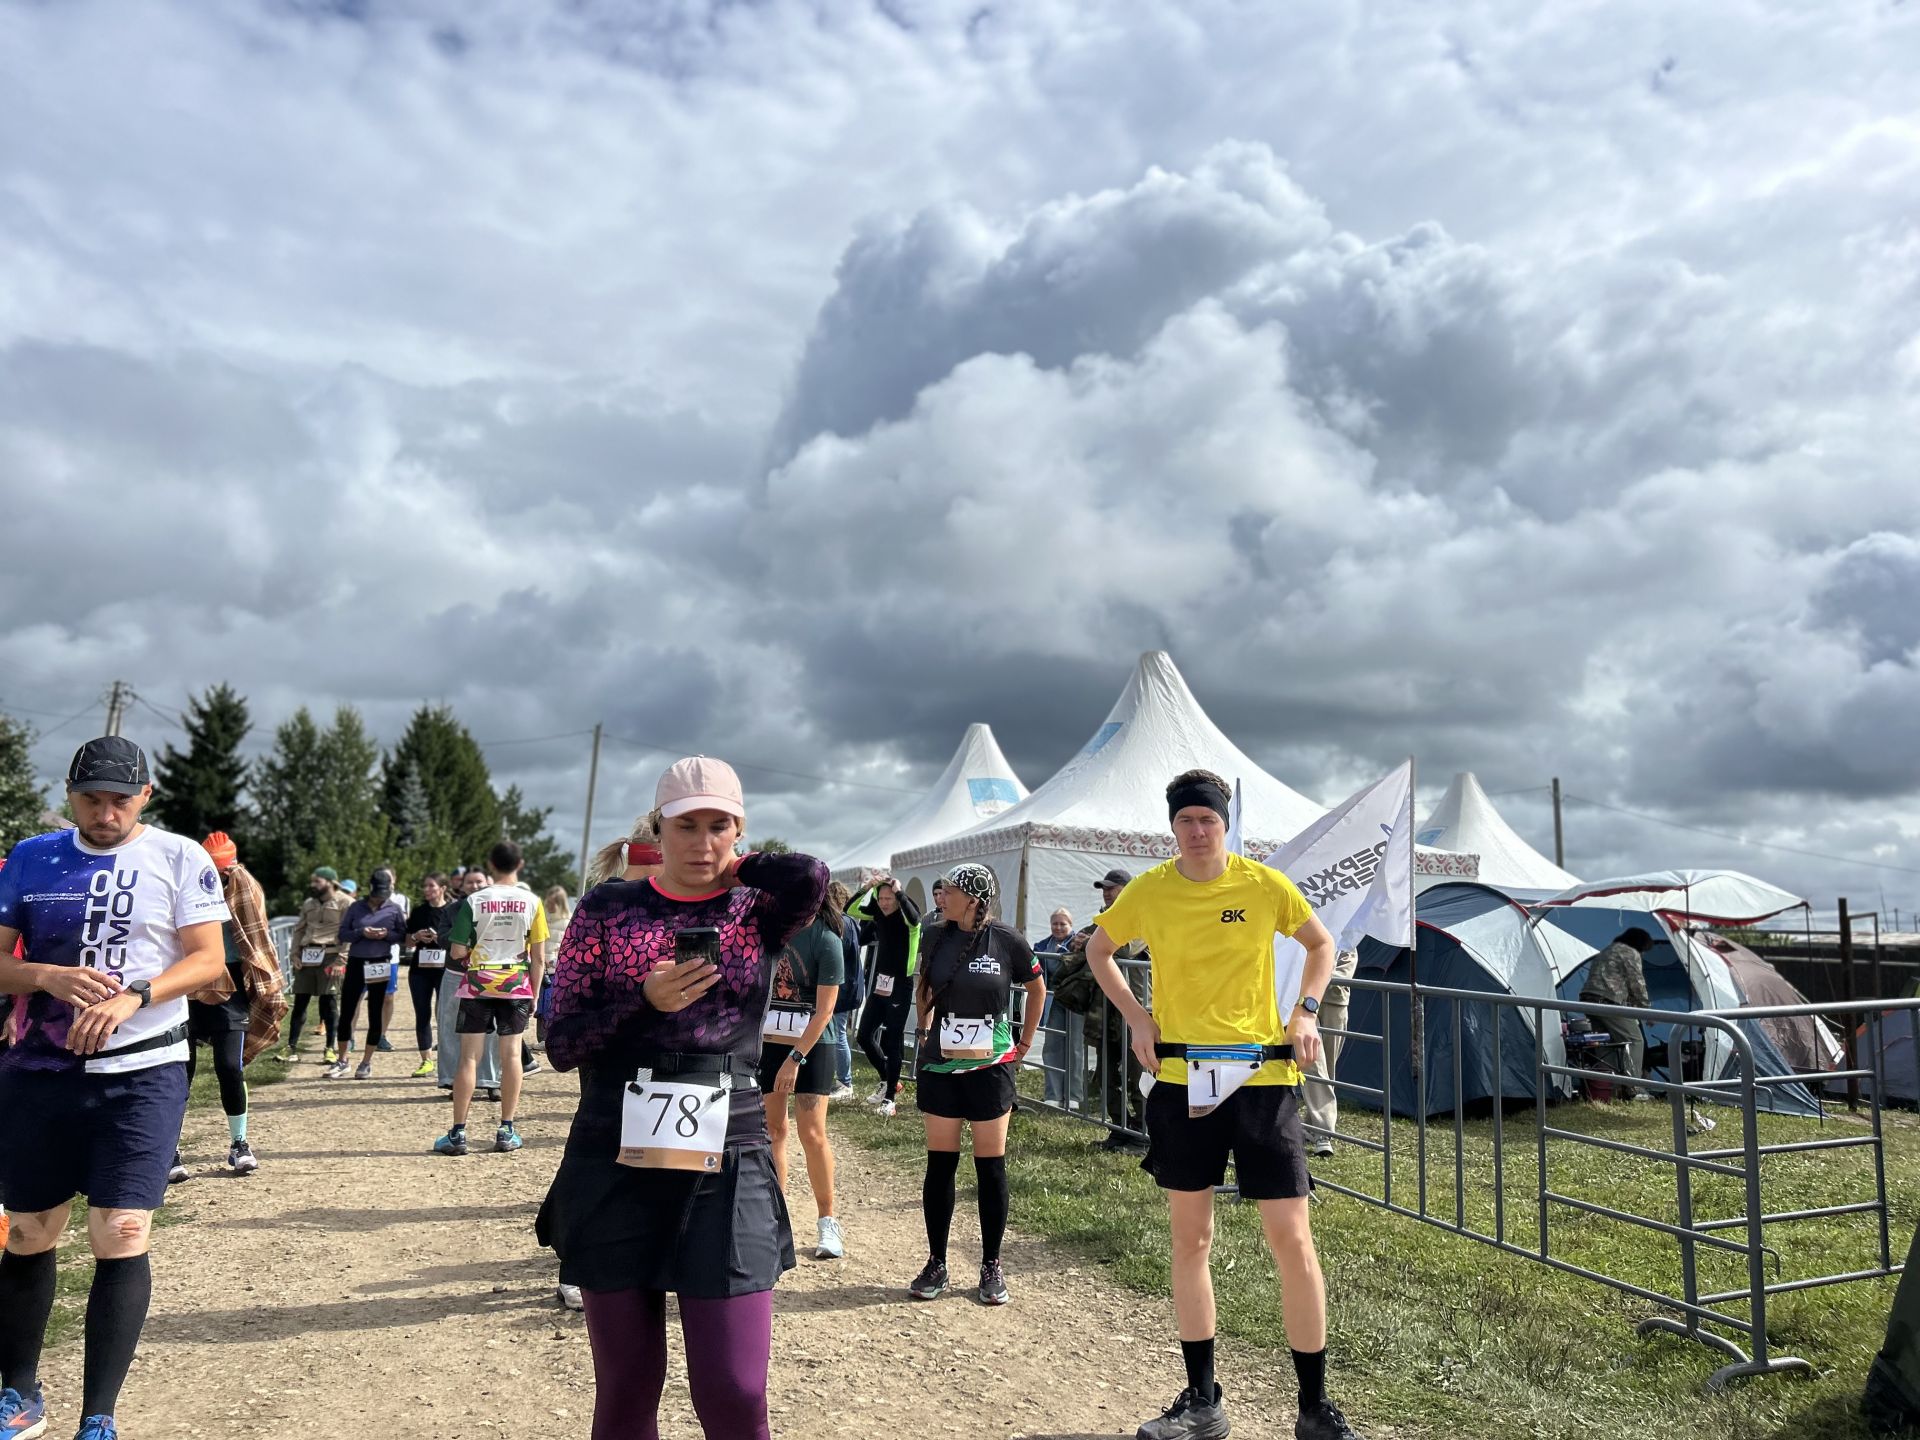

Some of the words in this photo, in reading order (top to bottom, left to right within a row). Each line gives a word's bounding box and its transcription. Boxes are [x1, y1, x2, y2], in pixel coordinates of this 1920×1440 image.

[480, 900, 526, 913] FINISHER
[1220, 909, 1247, 923] 8K
[426, 950, 441, 961] 70
[370, 965, 385, 976] 33
[775, 1011, 795, 1032] 11
[952, 1023, 980, 1045] 57
[1207, 1068, 1219, 1098] 1
[647, 1093, 701, 1138] 78
